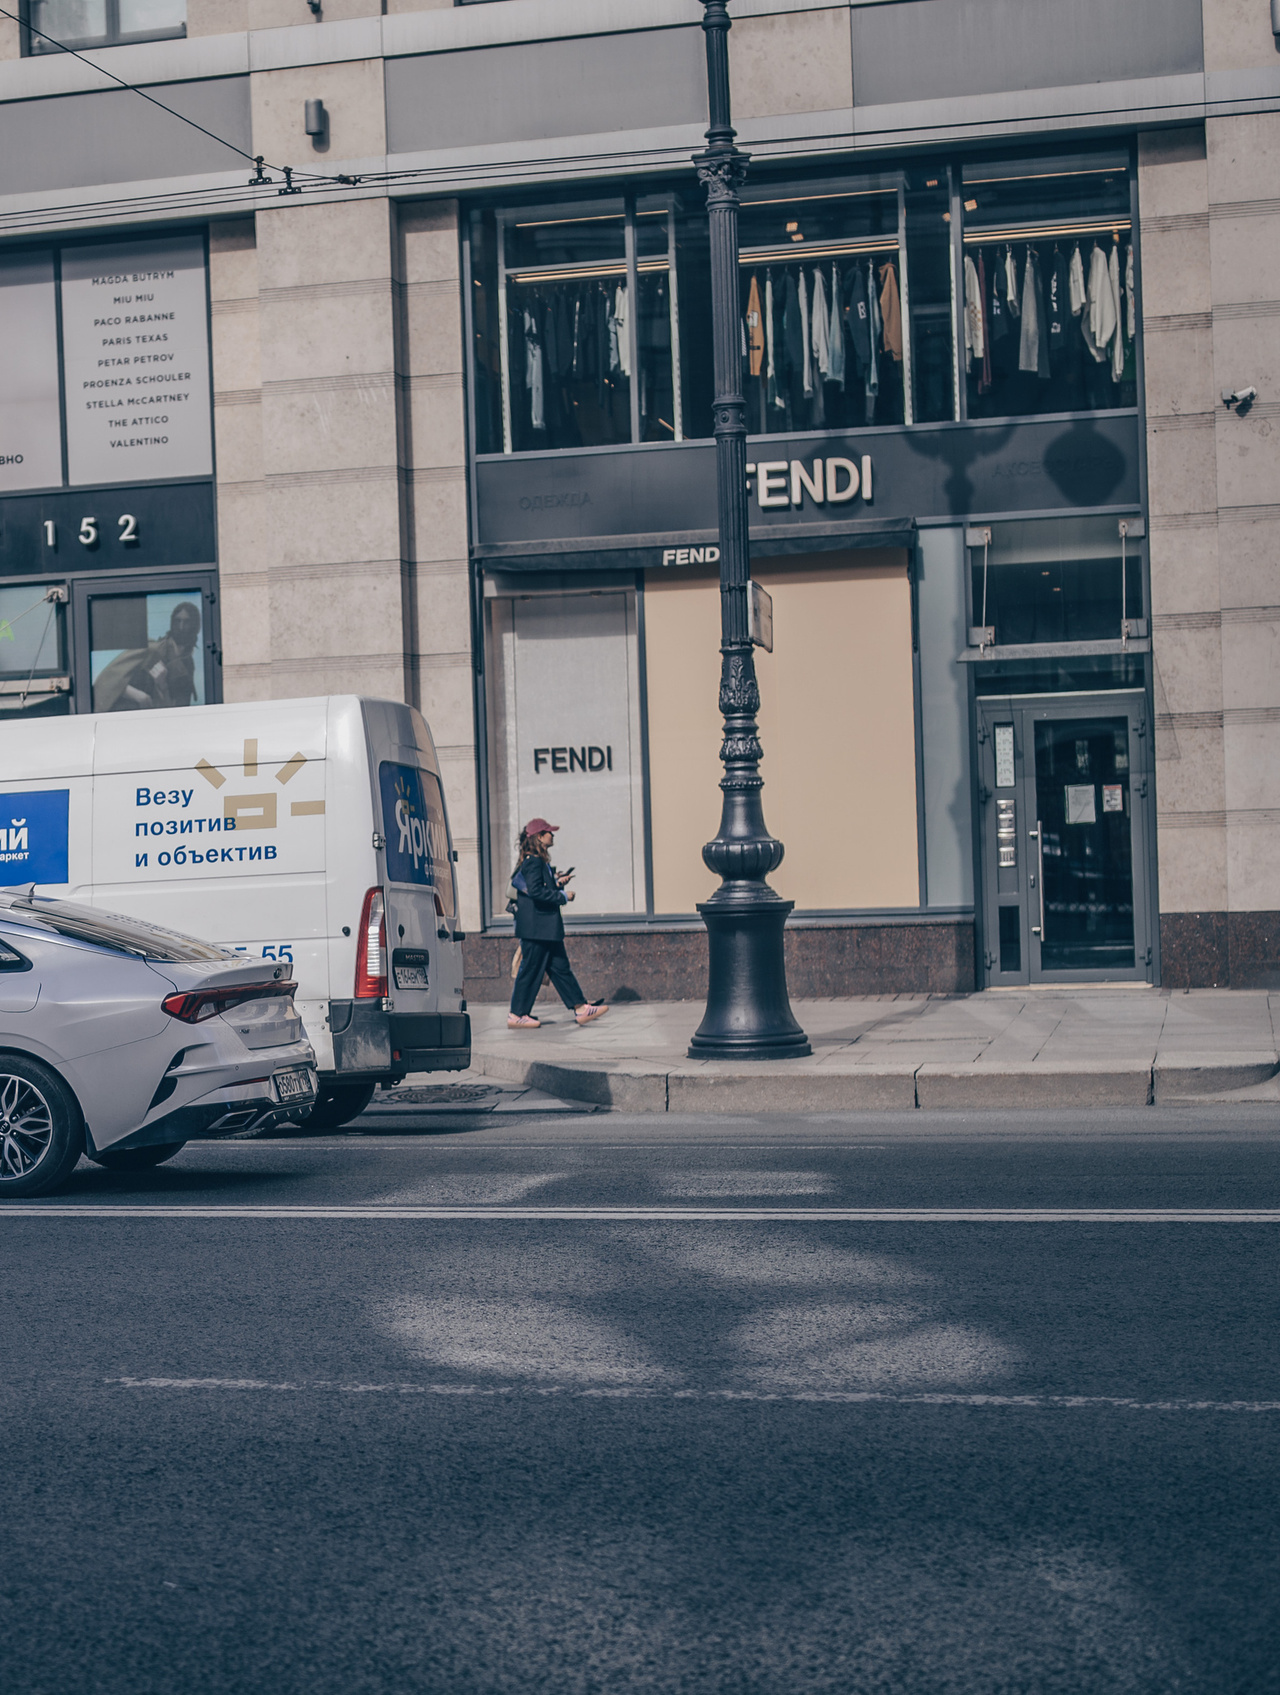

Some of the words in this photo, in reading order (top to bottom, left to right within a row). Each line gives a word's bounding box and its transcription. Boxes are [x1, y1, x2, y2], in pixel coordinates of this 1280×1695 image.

[91, 275, 129, 286] MAGDA
[132, 271, 175, 282] BUTRYM
[113, 295, 132, 304] MIU
[135, 293, 154, 303] MIU
[93, 317, 122, 327] PACO
[125, 312, 175, 324] RABANNE
[102, 336, 132, 346] PARIS
[135, 333, 169, 343] TEXAS
[98, 357, 130, 367] PETAR
[134, 353, 175, 364] PETROV
[83, 378, 132, 389] PROENZA
[136, 372, 191, 384] SCHOULER
[86, 399, 124, 409] STELLA
[127, 393, 190, 406] McCARTNEY
[108, 419, 128, 428] THE
[131, 415, 169, 426] ATTICO
[109, 436, 169, 448] VALENTINO
[43, 514, 137, 546] 152
[662, 546, 720, 567] FEND
[534, 745, 612, 774] FENDI
[135, 787, 194, 808] Везу
[135, 817, 237, 836] позитив
[135, 853, 148, 867] и
[158, 845, 278, 867] объектив
